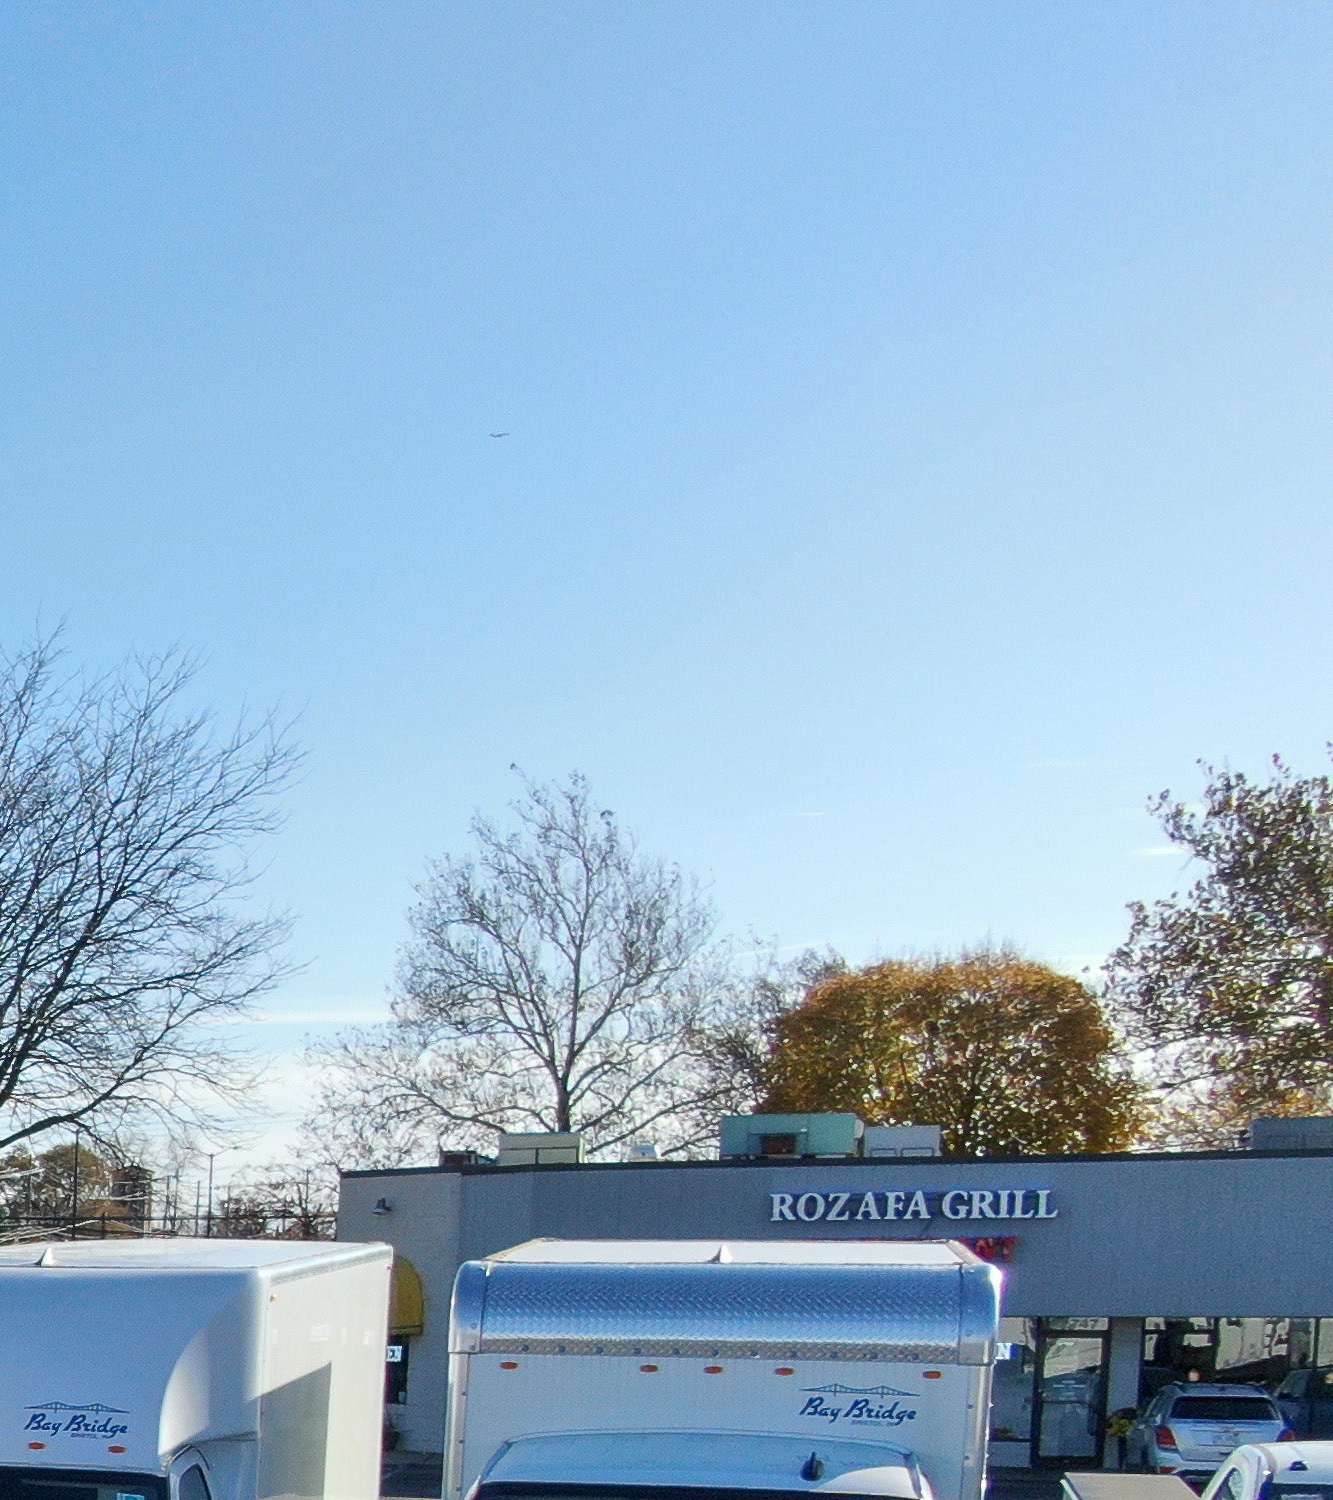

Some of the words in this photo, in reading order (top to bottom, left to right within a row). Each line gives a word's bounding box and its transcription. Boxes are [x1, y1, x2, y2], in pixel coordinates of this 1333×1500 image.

[770, 1190, 930, 1222] ROZAFA
[941, 1189, 1058, 1220] GRILL
[24, 1413, 62, 1436] Bay
[63, 1414, 128, 1438] Bridge
[798, 1396, 842, 1424] Bay
[844, 1398, 917, 1426] Bridge
